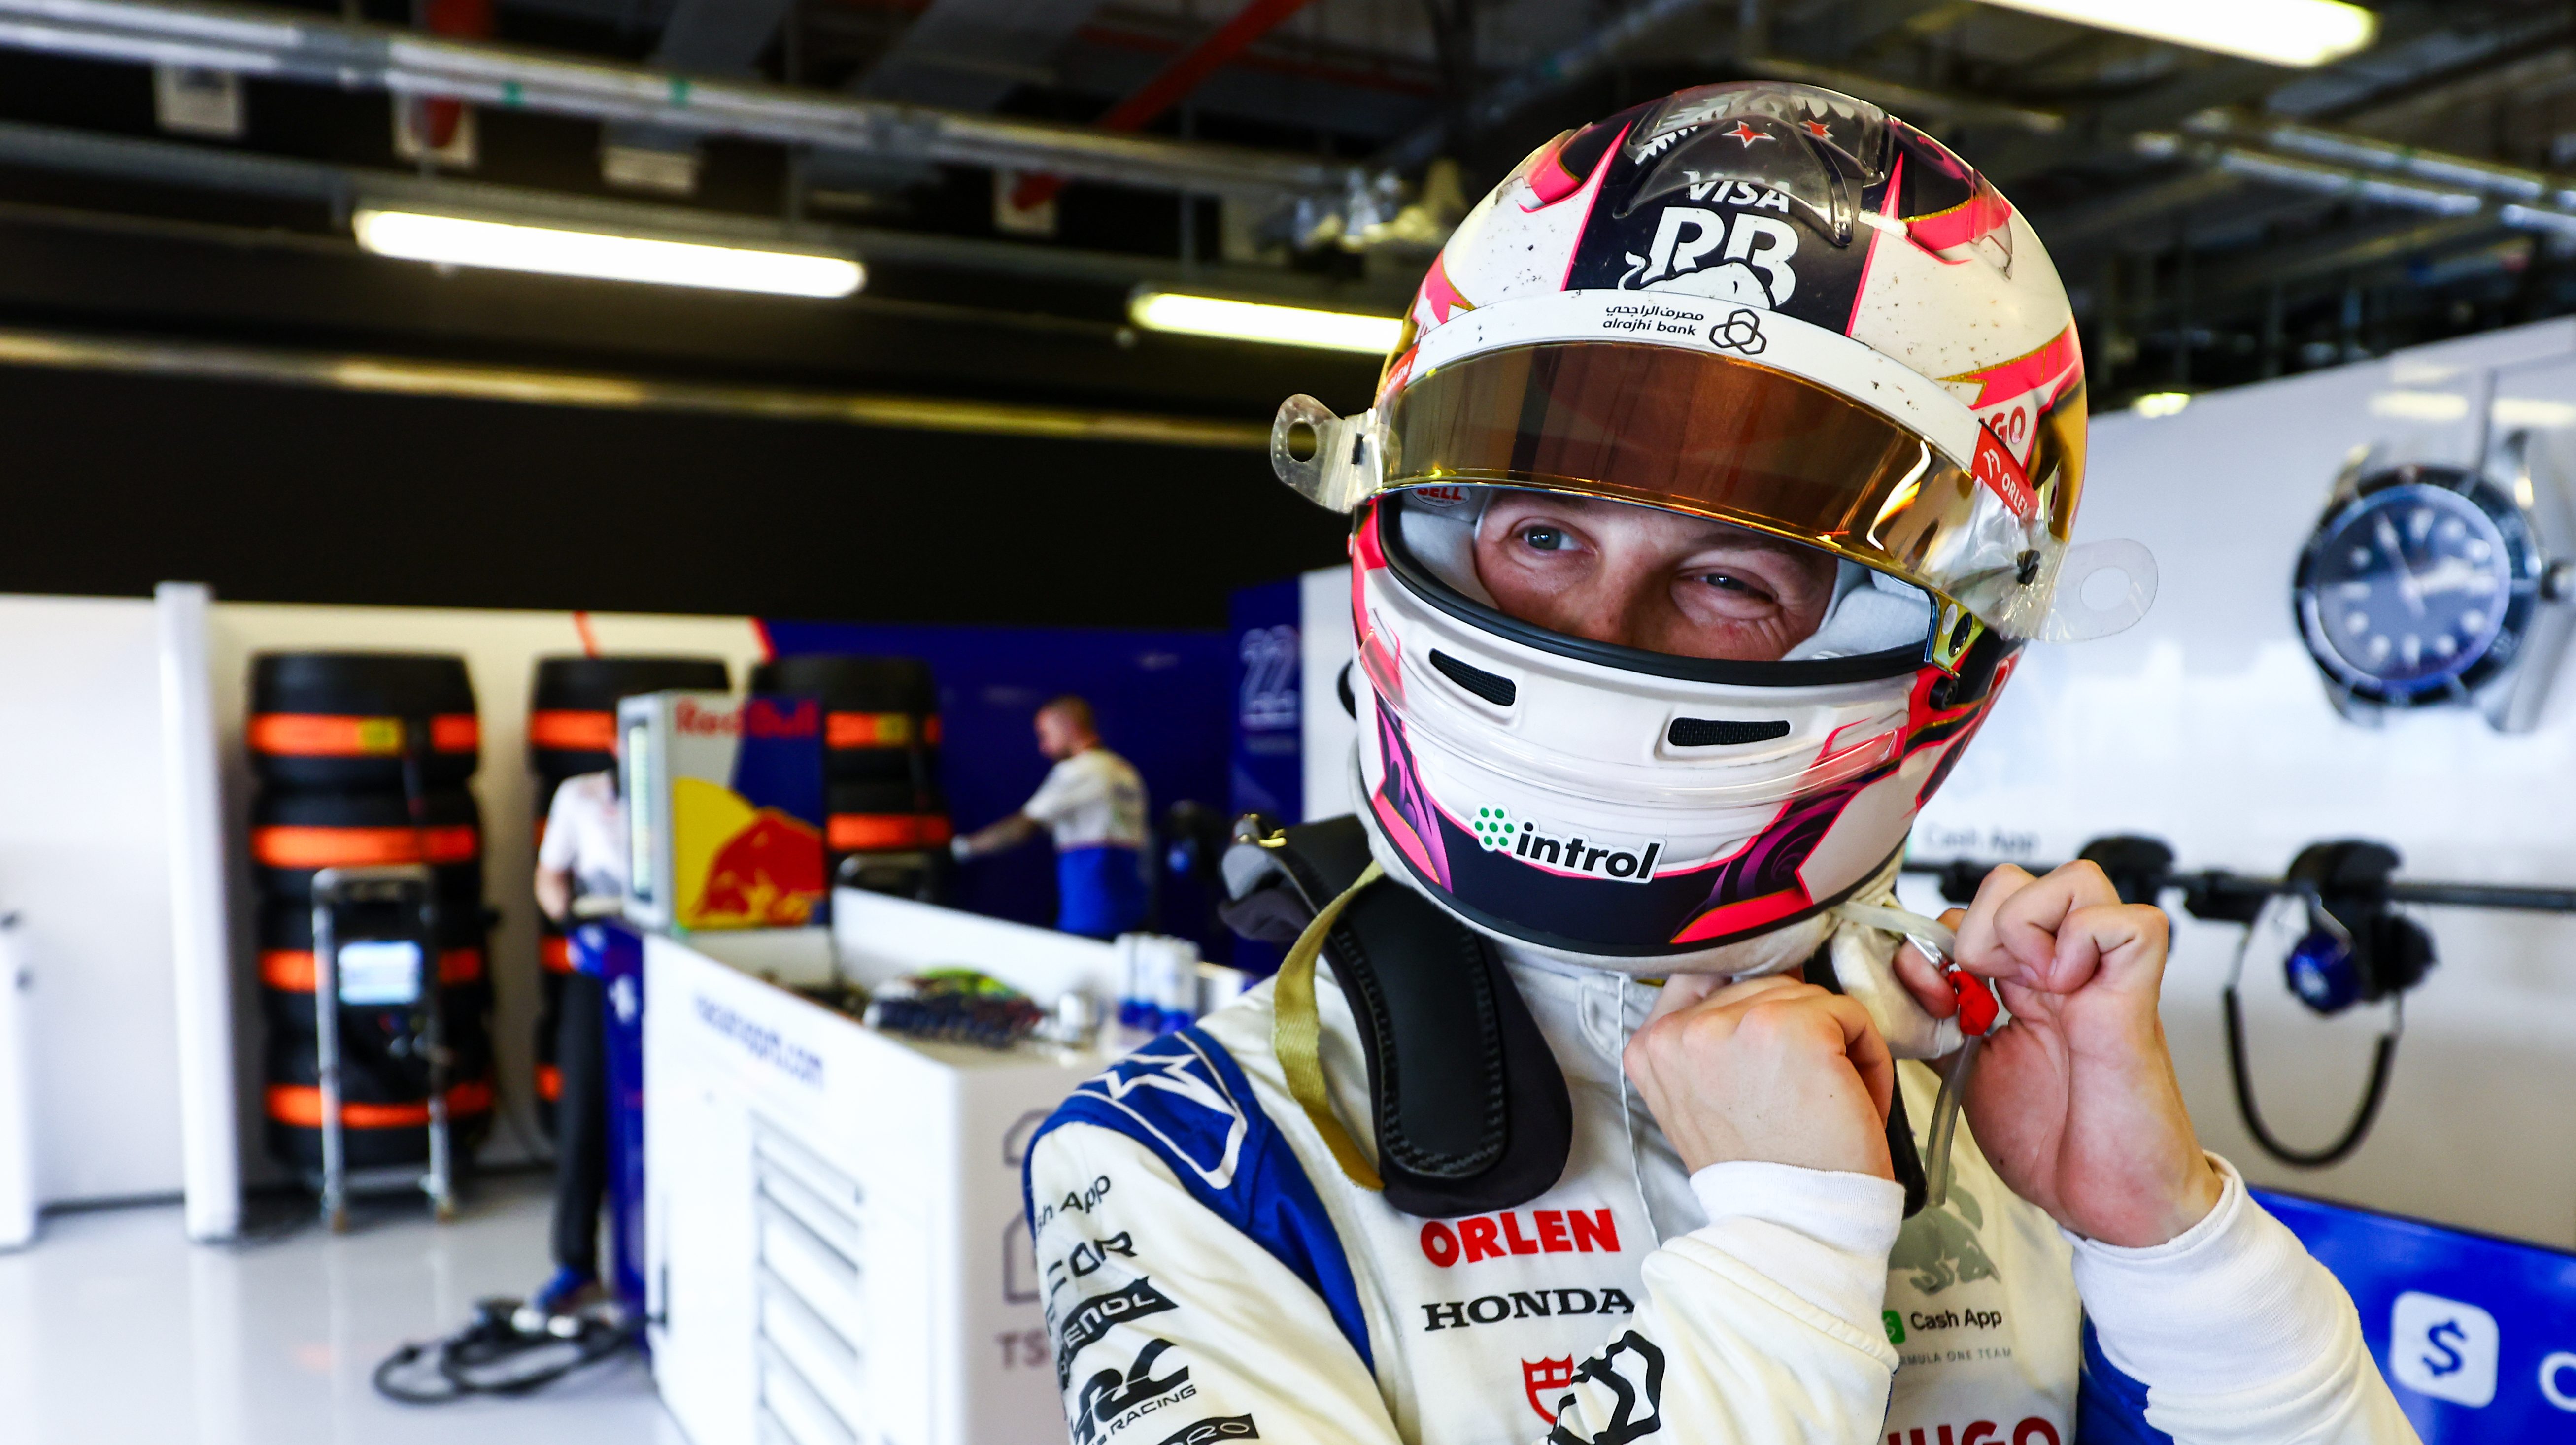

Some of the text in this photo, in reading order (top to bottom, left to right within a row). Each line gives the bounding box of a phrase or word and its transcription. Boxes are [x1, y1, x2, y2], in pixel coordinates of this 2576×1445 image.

[1683, 171, 1790, 213] VISA
[1603, 318, 1696, 336] alrajhi bank
[1606, 305, 1704, 321] مصرف الراجحي
[1516, 822, 1662, 879] introl
[1059, 1175, 1111, 1214] App
[1421, 1209, 1621, 1268] ORLEN
[1421, 1288, 1635, 1332] HONDA
[1910, 1308, 2002, 1331] Cash App
[1899, 1352, 1942, 1366] RMULA
[1110, 1384, 1197, 1435] RACING
